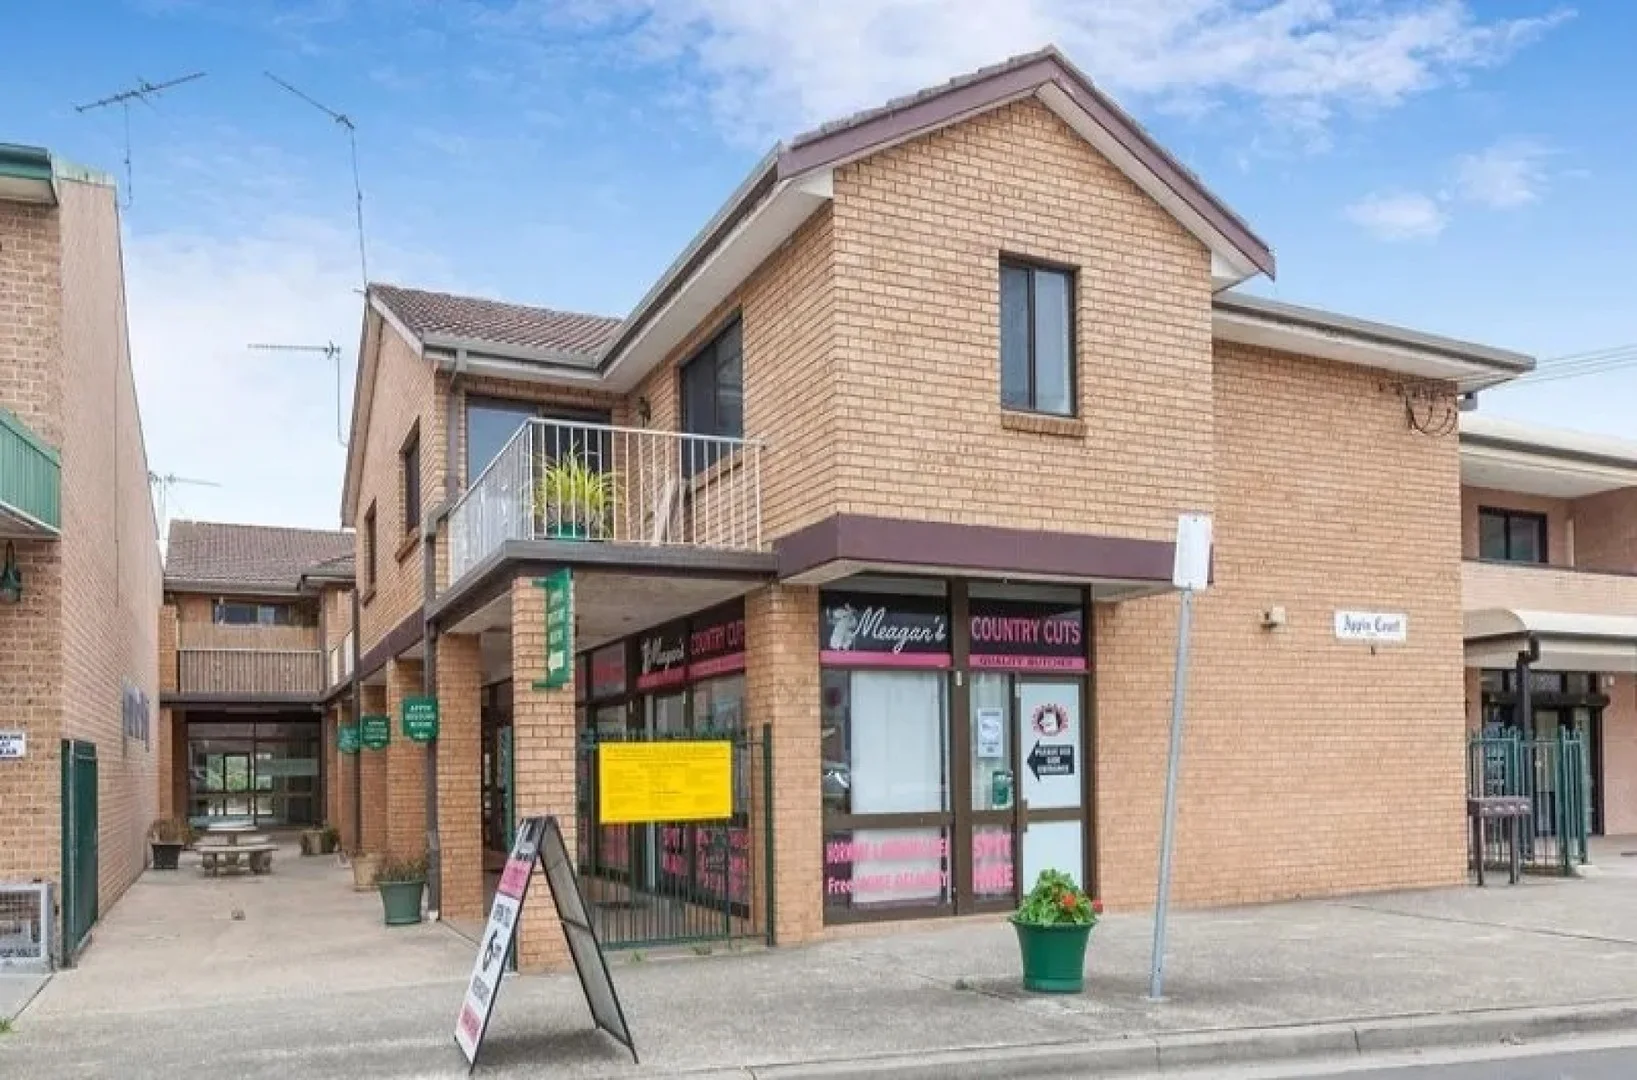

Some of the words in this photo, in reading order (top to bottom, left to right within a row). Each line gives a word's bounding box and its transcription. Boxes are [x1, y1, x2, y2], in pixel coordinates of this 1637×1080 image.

[851, 606, 946, 654] Meagan's
[971, 616, 1039, 643] COUNTRY
[1043, 618, 1081, 645] CUTS
